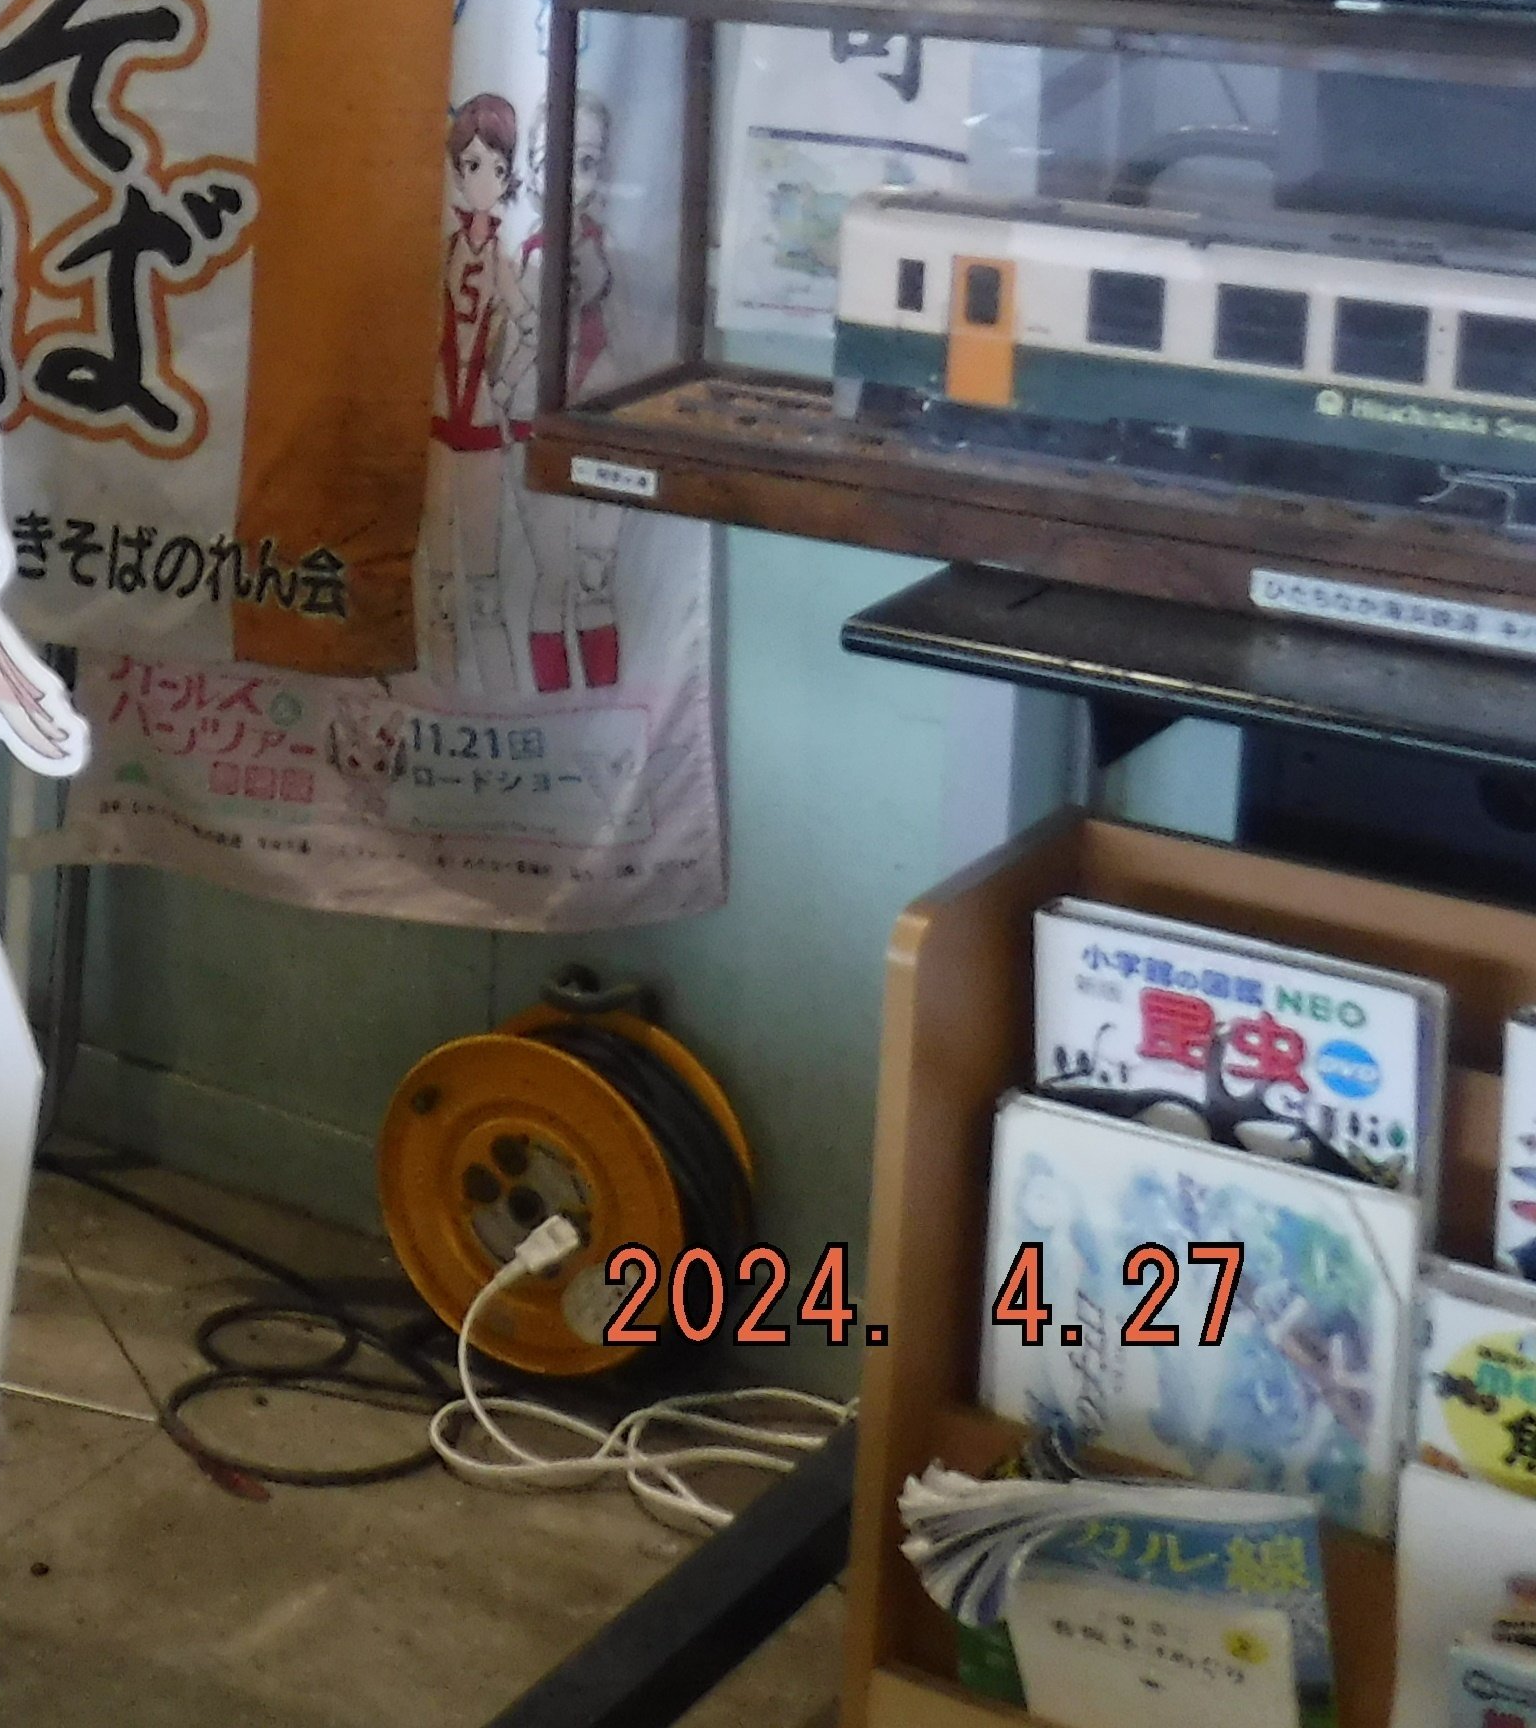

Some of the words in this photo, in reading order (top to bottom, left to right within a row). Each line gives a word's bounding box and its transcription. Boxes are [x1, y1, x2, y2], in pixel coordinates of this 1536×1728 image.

[12, 510, 348, 620] きそばのれん会
[1138, 987, 1310, 1093] 昆虫
[1274, 986, 1367, 1029] NEO
